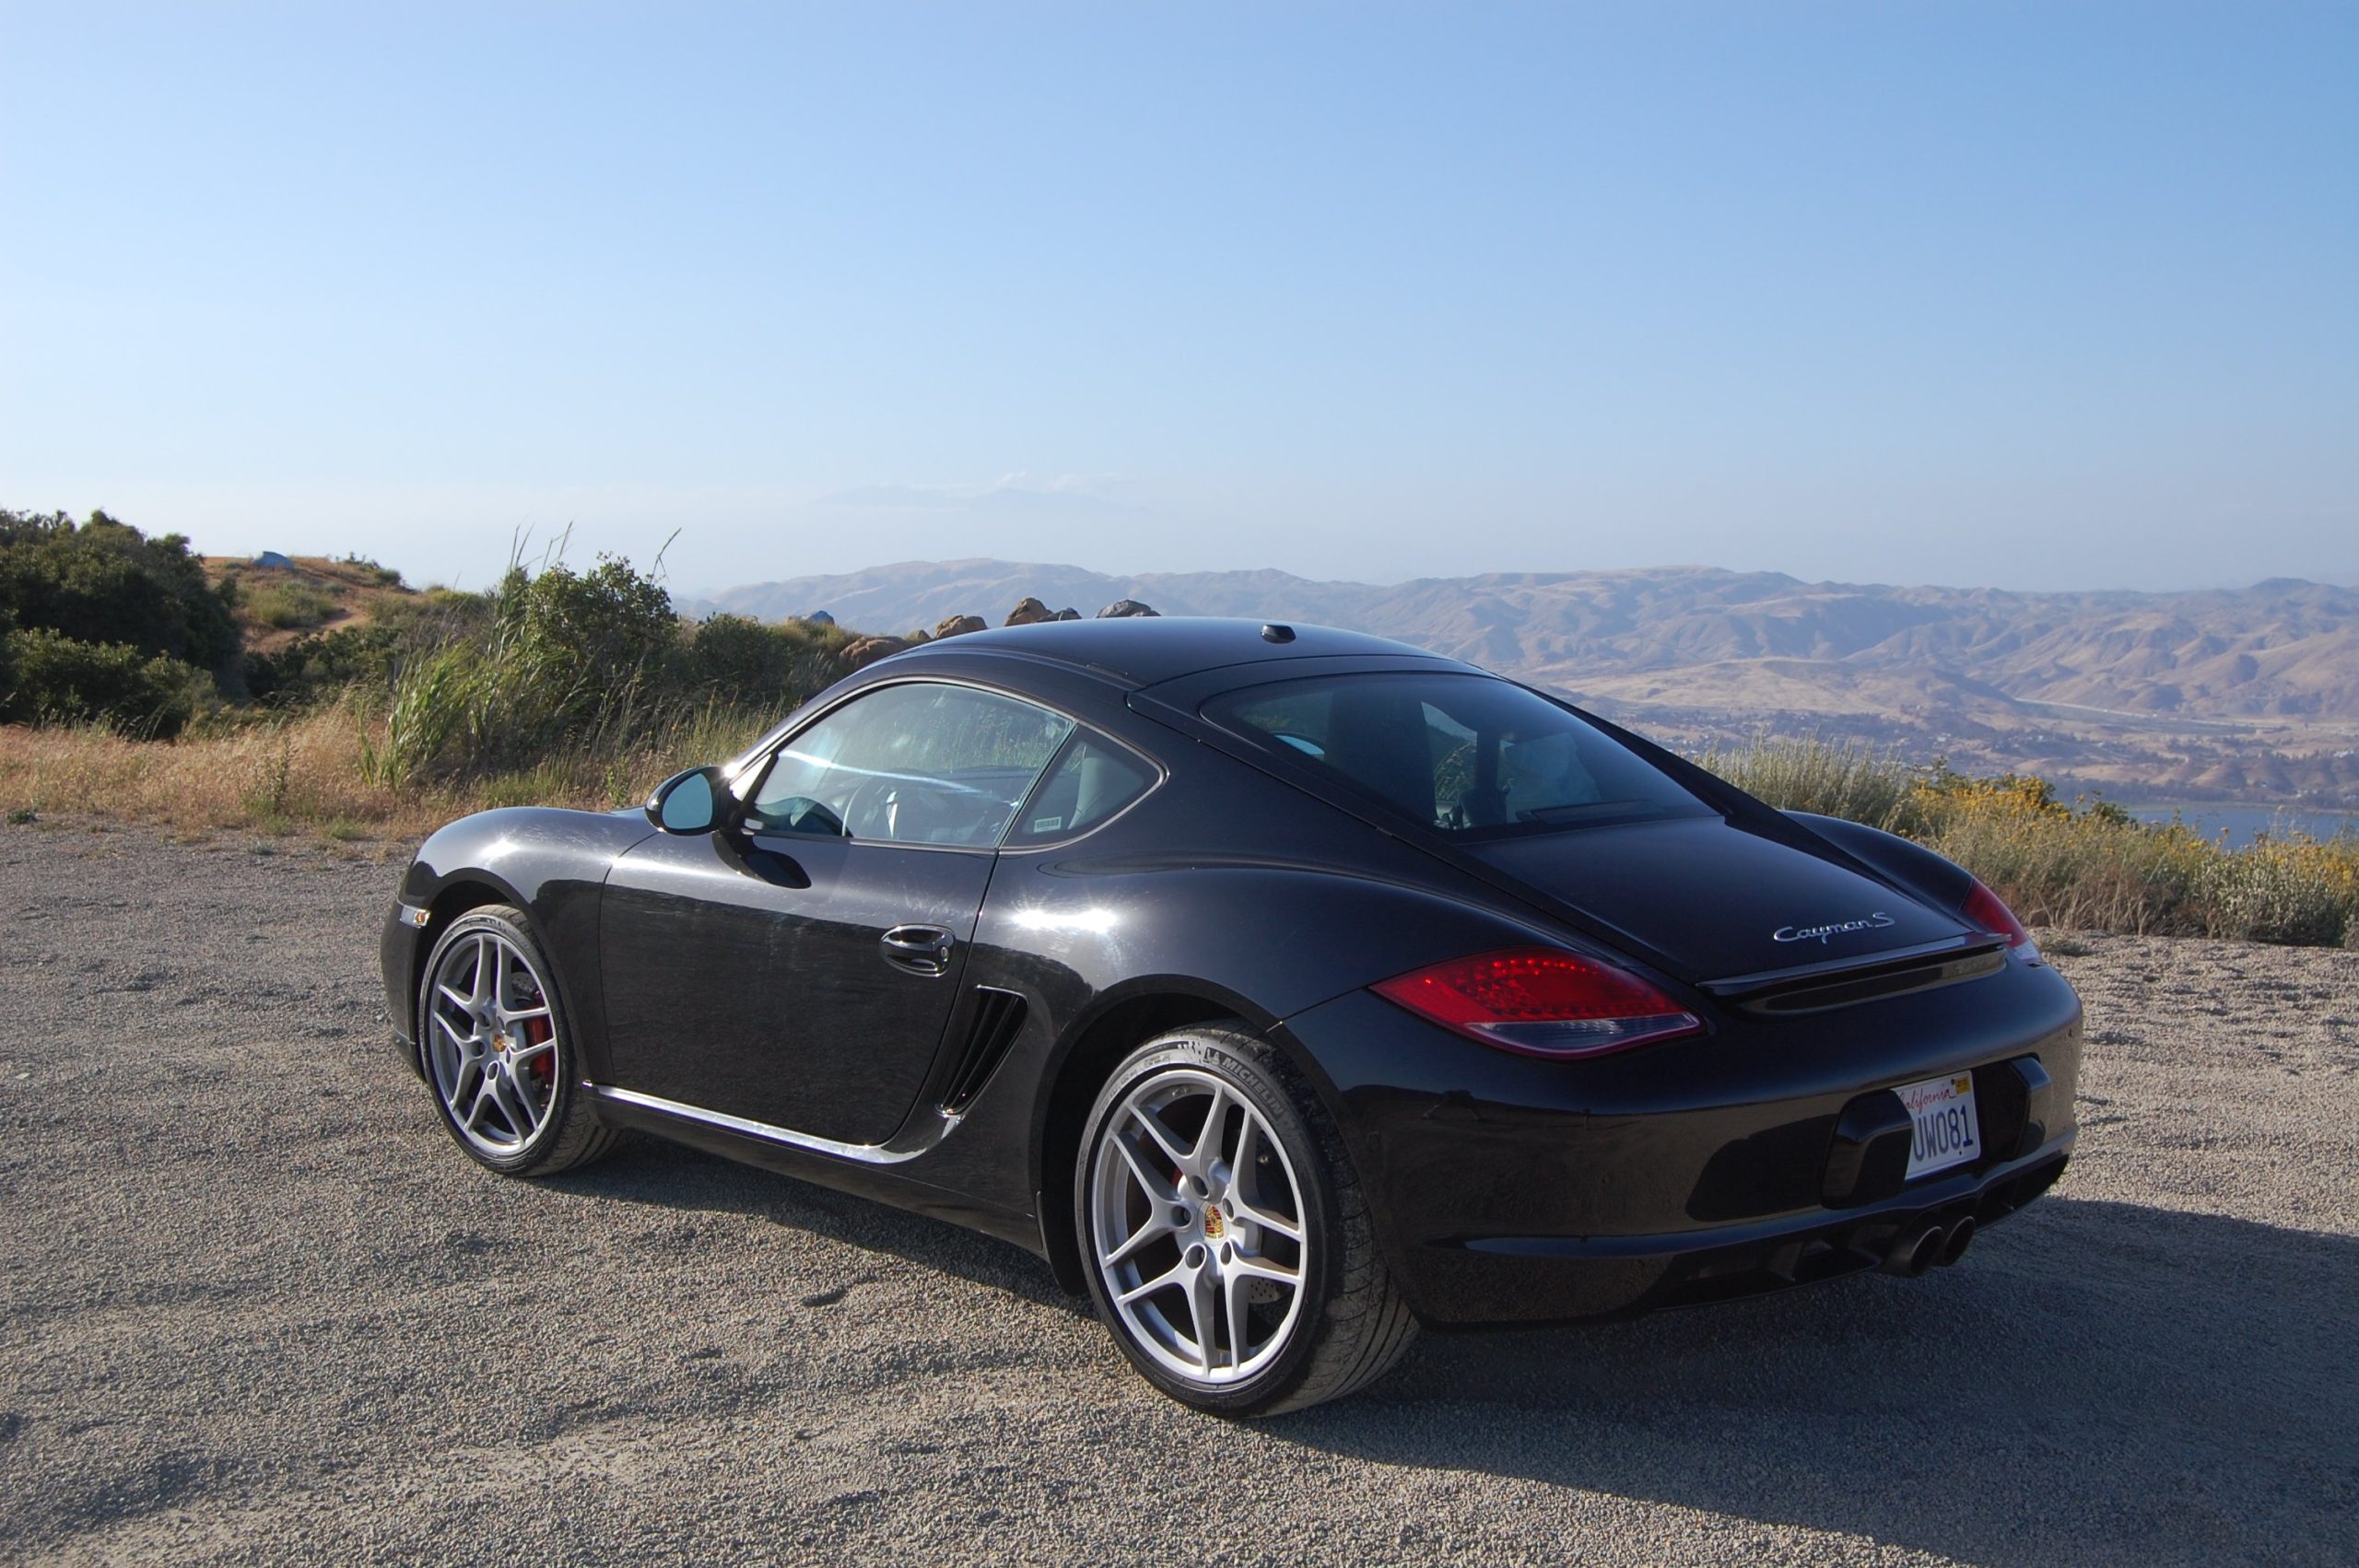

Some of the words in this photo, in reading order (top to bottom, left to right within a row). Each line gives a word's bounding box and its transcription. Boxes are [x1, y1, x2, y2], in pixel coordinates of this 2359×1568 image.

[1773, 912, 1872, 943] Cayman
[1872, 911, 1895, 928] S
[1223, 1058, 1285, 1116] MICHELIN
